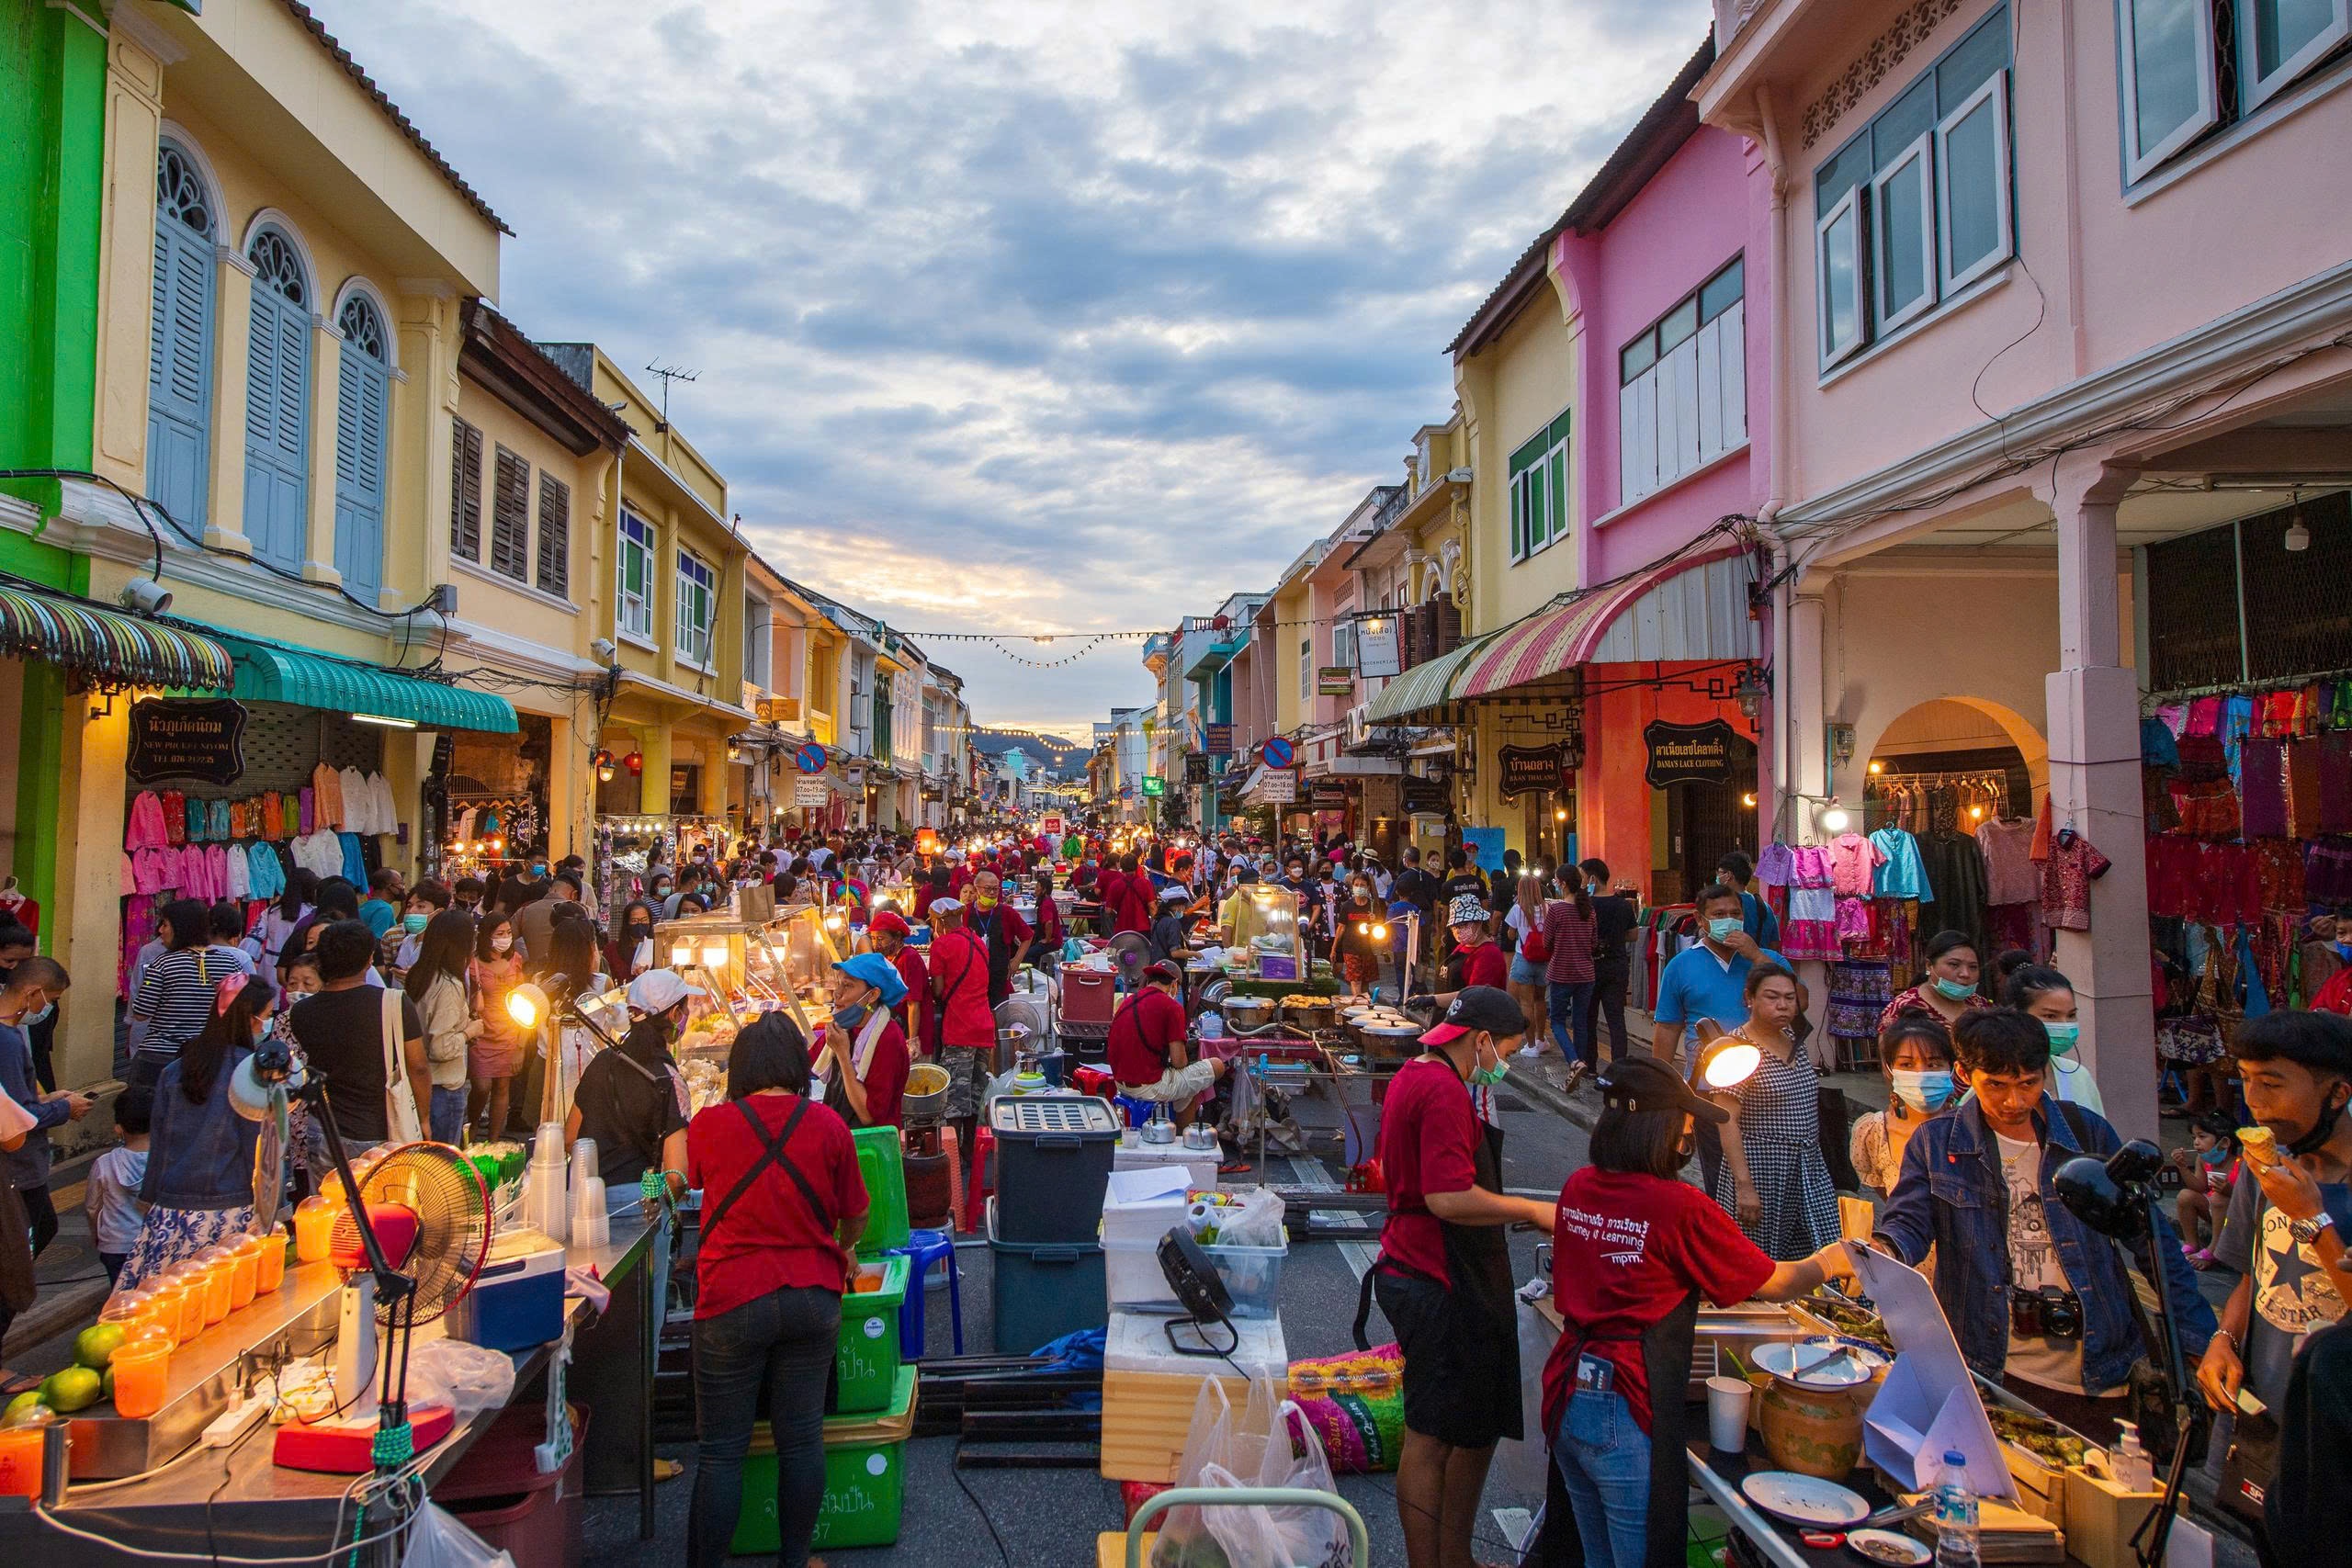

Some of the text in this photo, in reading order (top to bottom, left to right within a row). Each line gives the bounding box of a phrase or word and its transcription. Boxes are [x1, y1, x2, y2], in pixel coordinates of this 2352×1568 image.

[148, 716, 221, 737] นิวภูเก็ตนิยม
[1510, 757, 1555, 772] บ้านถลาง
[1657, 759, 1724, 768] DANIA'S LACE CLOTHING
[1607, 1218, 1650, 1239] การเรียนรู้
[1601, 1230, 1645, 1251] Learning
[2280, 1304, 2324, 1323] STAR
